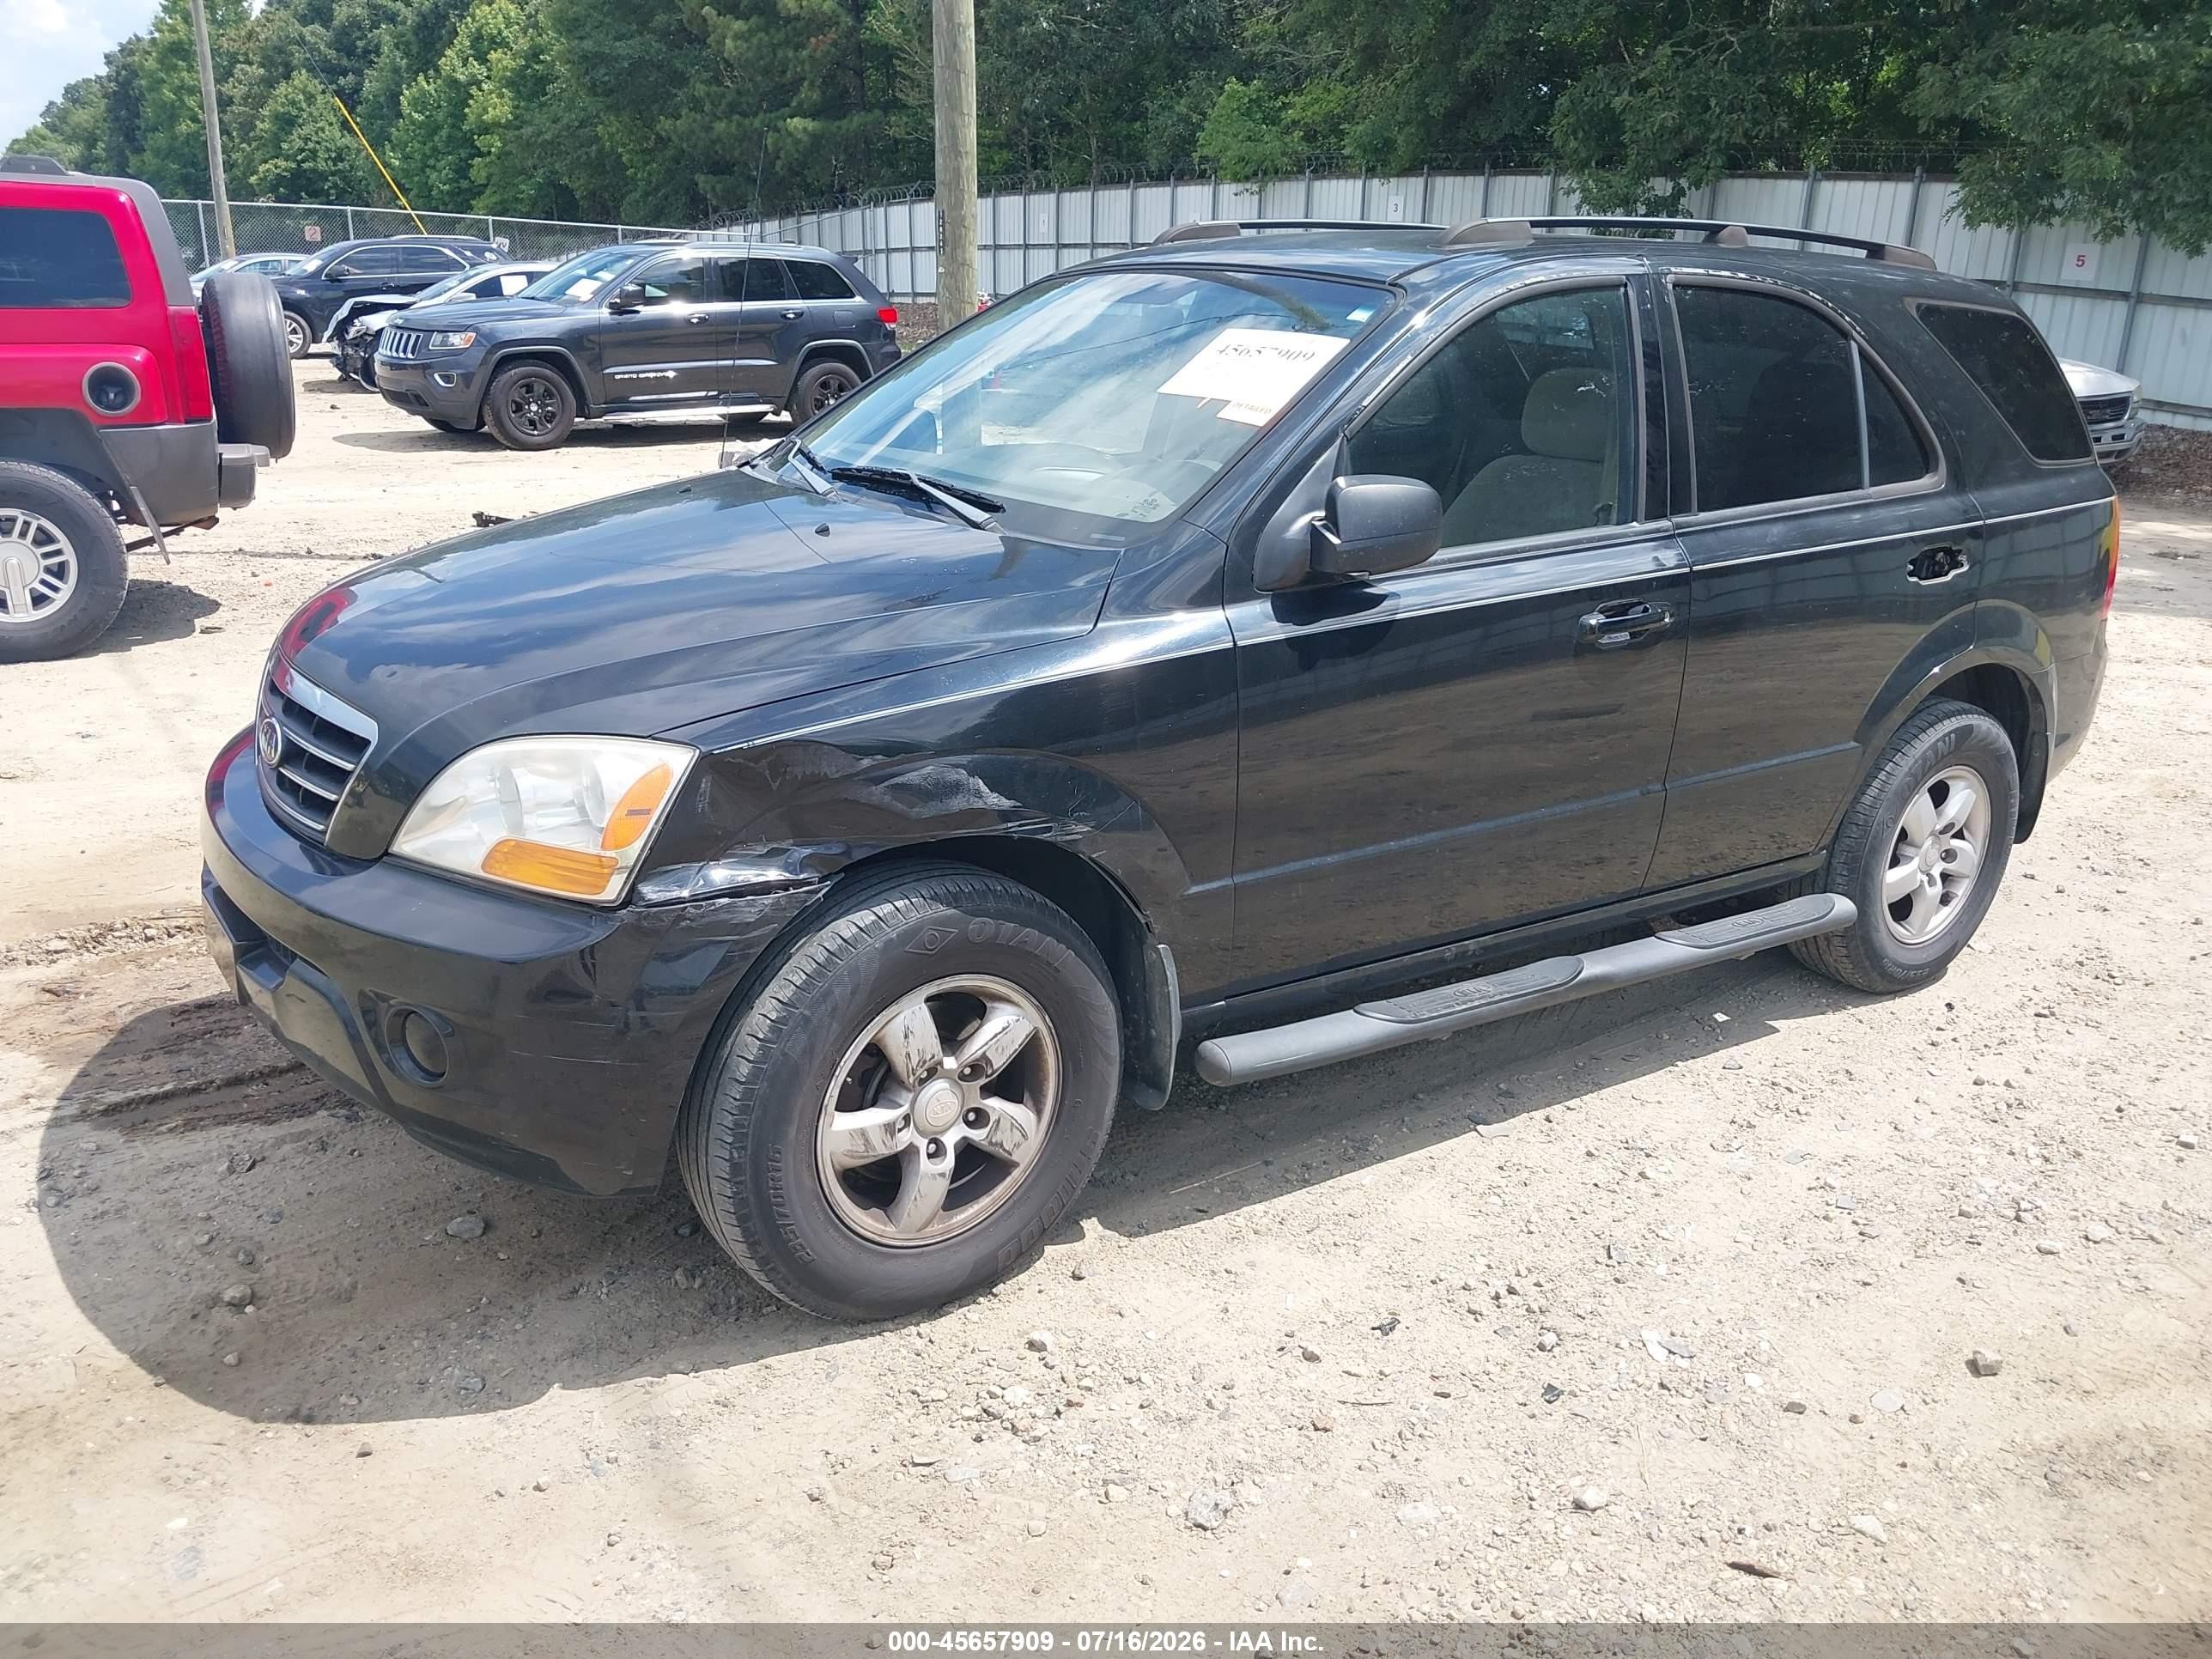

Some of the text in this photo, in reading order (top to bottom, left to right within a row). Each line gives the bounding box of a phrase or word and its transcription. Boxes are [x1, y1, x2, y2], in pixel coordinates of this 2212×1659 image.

[1393, 203, 1399, 213] 3
[2075, 254, 2087, 268] 5
[968, 917, 1074, 975] OTANI
